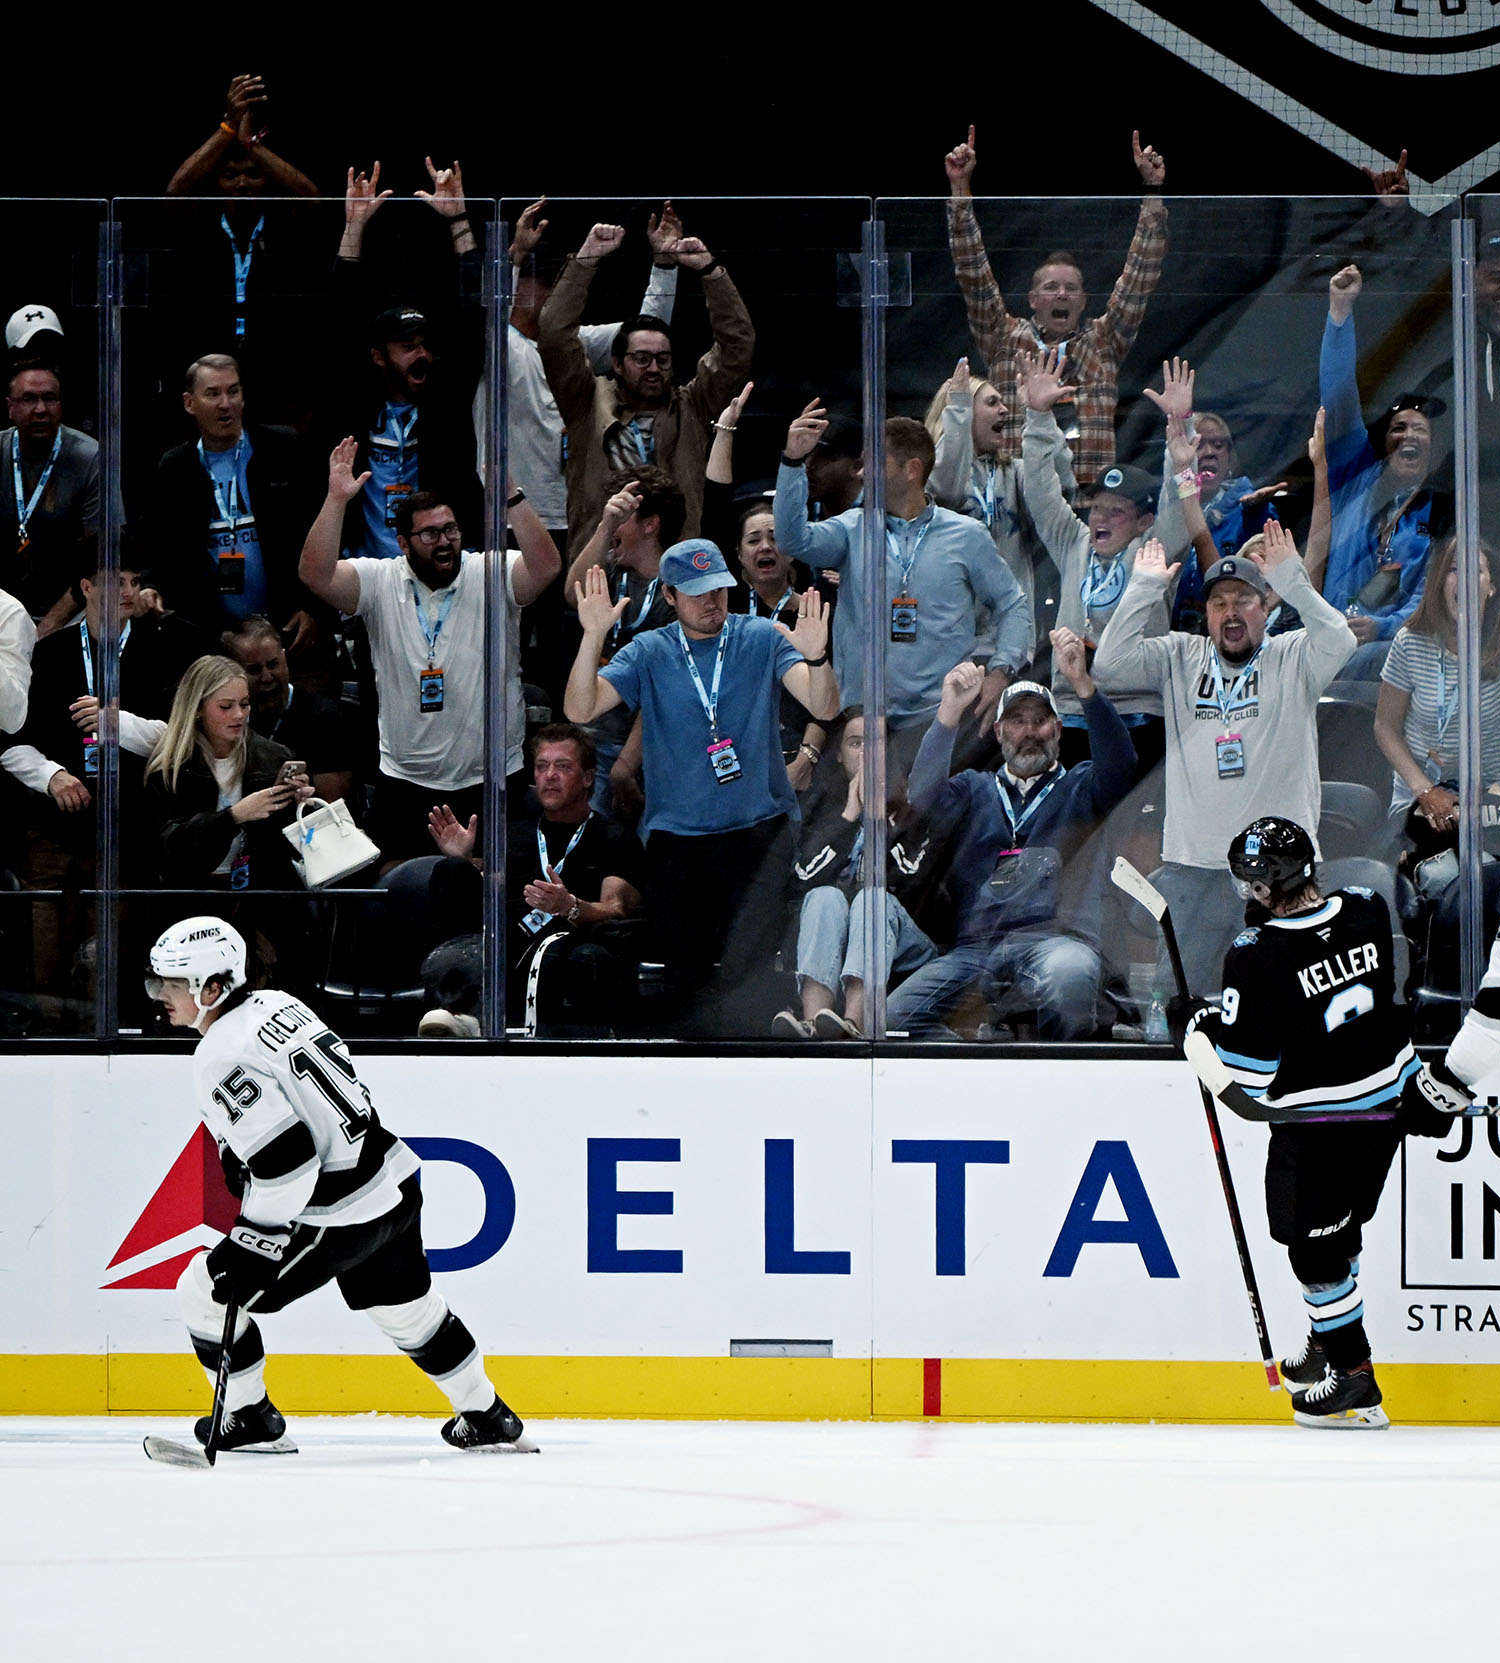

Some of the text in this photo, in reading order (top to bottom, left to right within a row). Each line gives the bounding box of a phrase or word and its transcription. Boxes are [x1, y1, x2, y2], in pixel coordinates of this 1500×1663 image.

[1234, 707, 1259, 721] CLUB
[189, 927, 220, 942] KINGS
[1297, 942, 1379, 999] KELLER
[1221, 987, 1240, 1026] 9
[212, 1065, 263, 1126] 15
[400, 1137, 1180, 1278] DELTA
